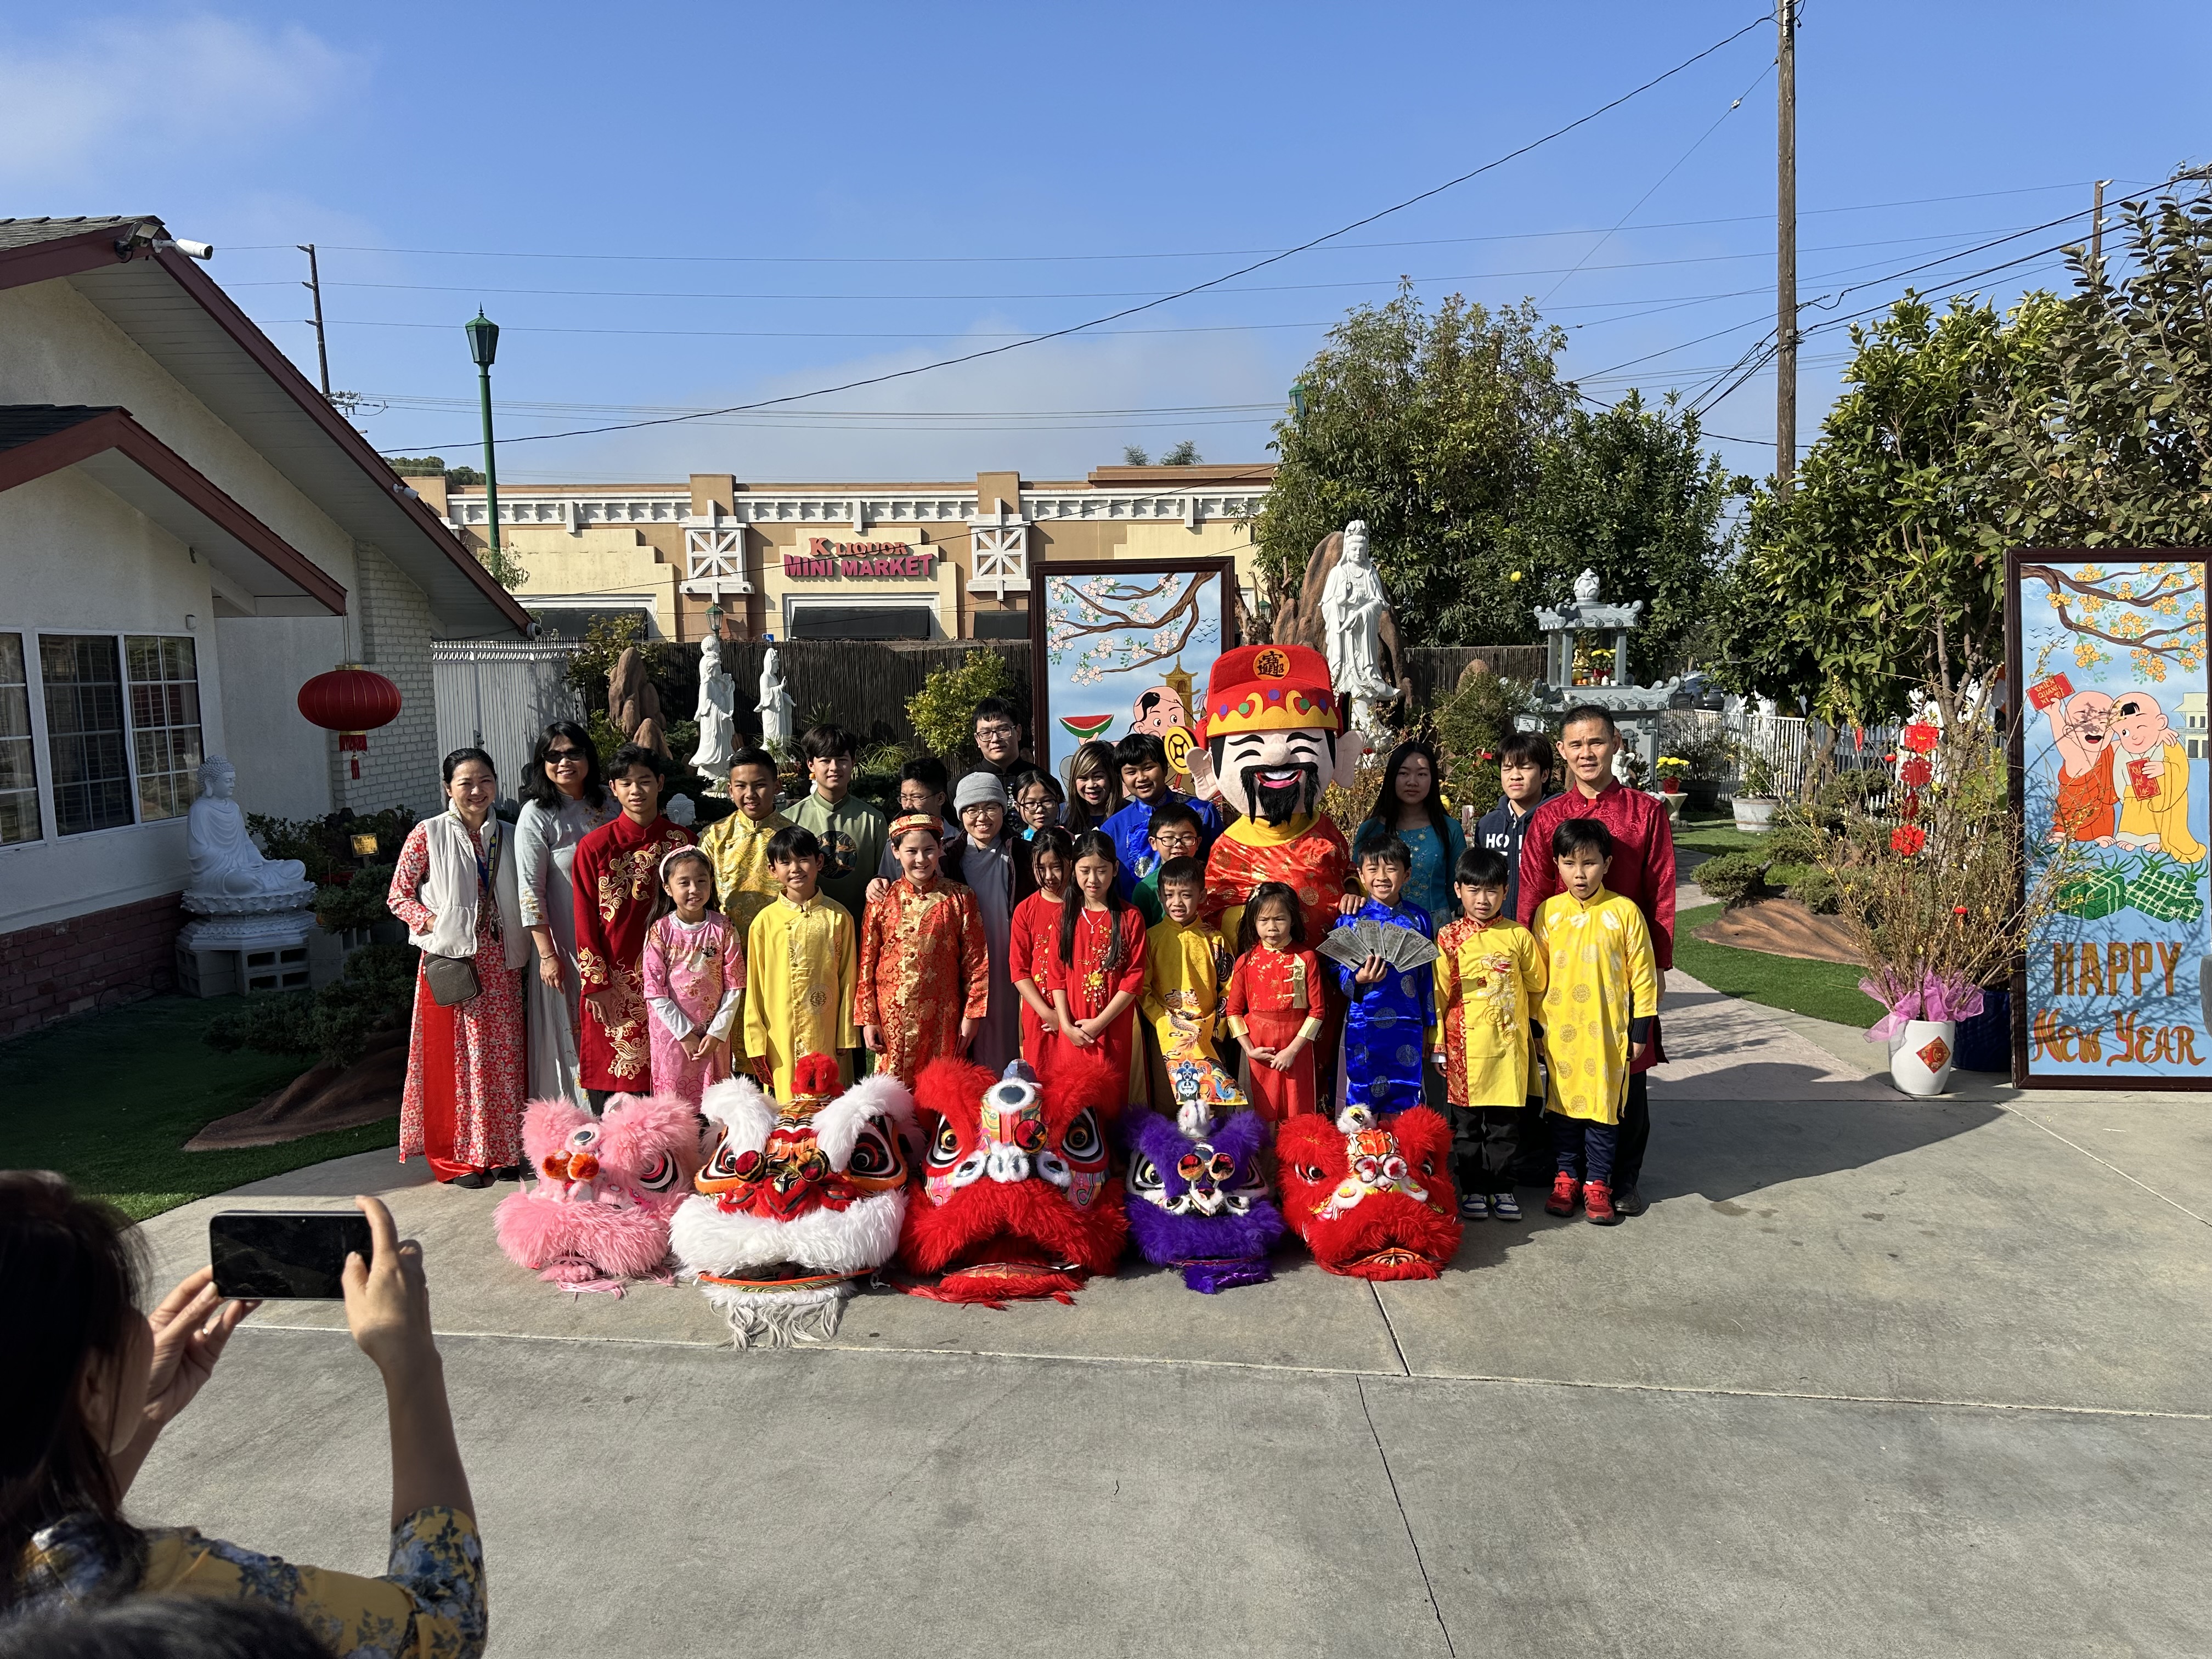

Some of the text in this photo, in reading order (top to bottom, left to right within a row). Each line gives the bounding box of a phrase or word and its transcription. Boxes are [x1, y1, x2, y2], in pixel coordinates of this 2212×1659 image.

[809, 538, 908, 558] K LIQUOR
[784, 553, 933, 576] MINI MARKET
[1333, 928, 1348, 938] 100
[2053, 942, 2182, 996] HAPPY
